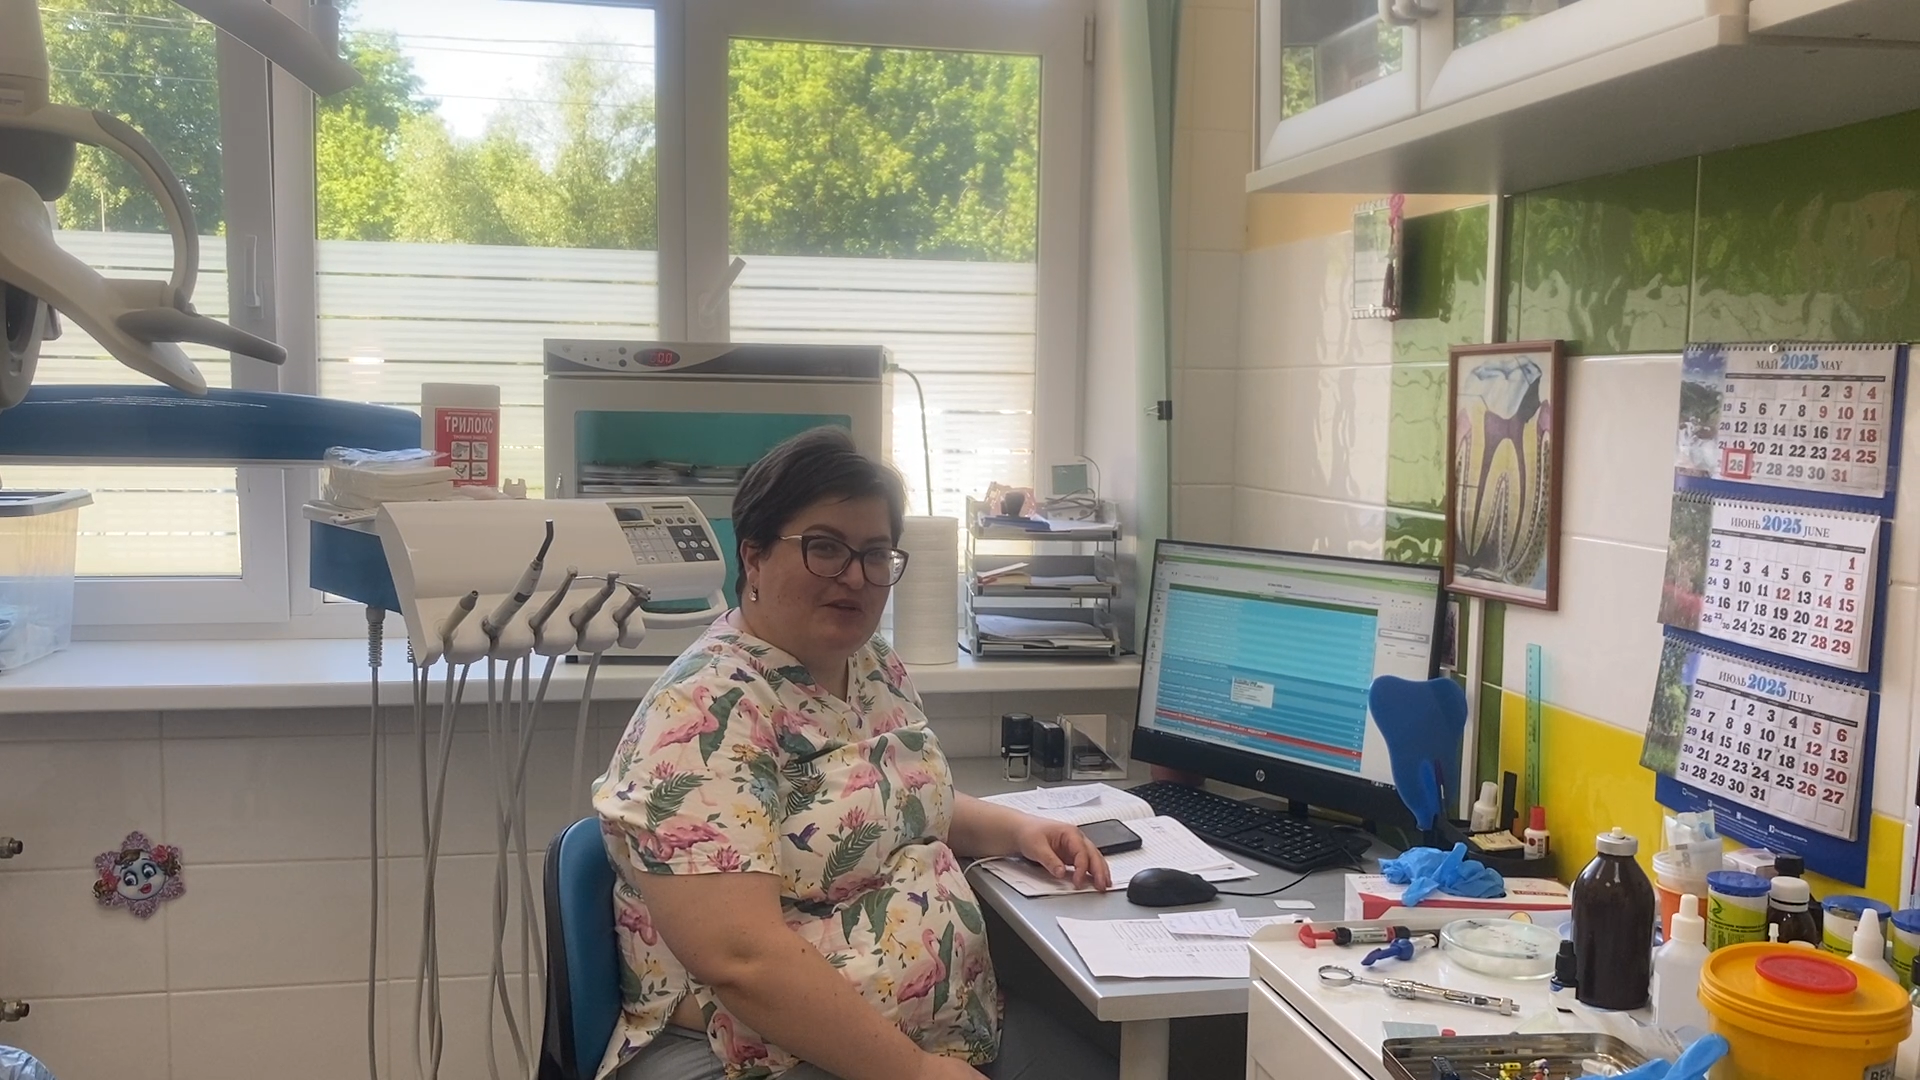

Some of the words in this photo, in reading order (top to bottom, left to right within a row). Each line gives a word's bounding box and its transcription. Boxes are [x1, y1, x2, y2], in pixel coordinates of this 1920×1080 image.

[1756, 358, 1778, 370] МАЙ
[1780, 354, 1819, 369] 2025
[1820, 361, 1843, 371] MAY
[1725, 385, 1734, 393] 18
[1801, 385, 1807, 397] 1
[1822, 385, 1829, 397] 2
[1843, 386, 1852, 398] 3
[1867, 386, 1876, 399] 4
[444, 416, 494, 434] ТРИЛОКС
[1724, 403, 1731, 412] 19
[1739, 403, 1746, 414] 5
[1759, 404, 1766, 415] 6
[1779, 404, 1786, 415] 7
[1798, 405, 1806, 416] 8
[1819, 406, 1827, 418] 9
[1838, 407, 1853, 419] 10
[1862, 408, 1876, 421] 11
[1720, 422, 1730, 430] 20
[1735, 422, 1747, 433] 12
[1753, 423, 1767, 434] 13
[1773, 424, 1786, 435] 14
[1793, 425, 1806, 437] 15
[1813, 426, 1828, 439] 16
[1835, 428, 1851, 440] 17
[1859, 429, 1876, 442] 18
[1718, 441, 1727, 449] 21
[1733, 441, 1745, 450] 19
[1750, 441, 1765, 453] 20
[1770, 443, 1784, 455] 21
[1789, 445, 1805, 457] 22
[1810, 447, 1826, 459] 23
[1831, 448, 1850, 461] 24
[1856, 450, 1876, 463] 25
[1729, 459, 1743, 470] 26
[1766, 463, 1782, 475] 28
[1787, 464, 1803, 477] 29
[1808, 467, 1825, 480] 30
[1831, 469, 1847, 482] 31
[1731, 517, 1761, 529] ИЮНЬ
[1763, 515, 1801, 534] 2025
[1803, 527, 1829, 538] JUNE
[1712, 540, 1721, 548] 22
[1849, 557, 1855, 570] 1
[1710, 559, 1719, 567] 23
[1725, 559, 1731, 570] 2
[1743, 562, 1750, 574] 3
[1762, 565, 1769, 577] 4
[1781, 568, 1789, 580] 5
[1803, 571, 1811, 583] 6
[1824, 575, 1832, 587] 7
[1845, 578, 1854, 590] 8
[1708, 577, 1717, 585] 24
[1723, 578, 1730, 589] 9
[1738, 581, 1750, 593] 10
[1758, 585, 1768, 596] 11
[1776, 588, 1790, 600] 12
[1798, 591, 1811, 604] 13
[1818, 595, 1831, 608] 14
[1839, 598, 1854, 612] 15
[1706, 596, 1714, 604] 25
[1718, 597, 1730, 609] 16
[1737, 600, 1749, 612] 17
[1754, 603, 1767, 616] 18
[1773, 607, 1788, 620] 19
[1794, 611, 1809, 624] 20
[1815, 615, 1828, 628] 21
[1834, 619, 1853, 633] 22
[1703, 614, 1712, 623] 26
[1732, 619, 1747, 632] 24
[1750, 623, 1764, 636] 25
[1770, 626, 1786, 640] 26
[1792, 631, 1807, 645] 27
[1811, 634, 1827, 649] 28
[1831, 639, 1850, 654] 29
[1719, 671, 1746, 686] ИЮЛЬ
[1749, 674, 1787, 697] 2025
[1788, 690, 1814, 705] JULY
[1694, 690, 1704, 699] 27
[1730, 700, 1736, 710] 1
[1747, 704, 1754, 716] 2
[1767, 710, 1775, 722] 3
[1789, 716, 1797, 728] 4
[1813, 722, 1821, 735] 5
[1837, 729, 1847, 742] 6
[1690, 708, 1701, 717] 28
[1708, 712, 1715, 723] 7
[1726, 717, 1734, 729] 8
[1743, 723, 1751, 735] 9
[1760, 728, 1774, 742] 10
[1784, 735, 1797, 749] 11
[1806, 742, 1822, 756] 12
[1830, 749, 1848, 764] 13
[1687, 726, 1697, 736] 29
[1701, 729, 1714, 743] 14
[1720, 735, 1732, 749] 15
[1737, 742, 1750, 755] 16
[1757, 749, 1771, 762] 17
[1779, 754, 1795, 769] 18
[1803, 761, 1819, 776] 19
[1825, 768, 1847, 784] 20
[1680, 763, 1688, 772] 31
[1692, 765, 1707, 780] 28
[1710, 772, 1725, 787] 29
[1728, 779, 1744, 794] 30
[1750, 786, 1766, 801] 31
[1683, 745, 1693, 754] 30
[1697, 747, 1709, 761] 21
[1714, 753, 1729, 768] 22
[1733, 759, 1747, 774] 23
[1752, 766, 1770, 782] 24
[1776, 773, 1794, 790] 25
[1797, 781, 1816, 797] 26
[1823, 789, 1844, 805] 27
